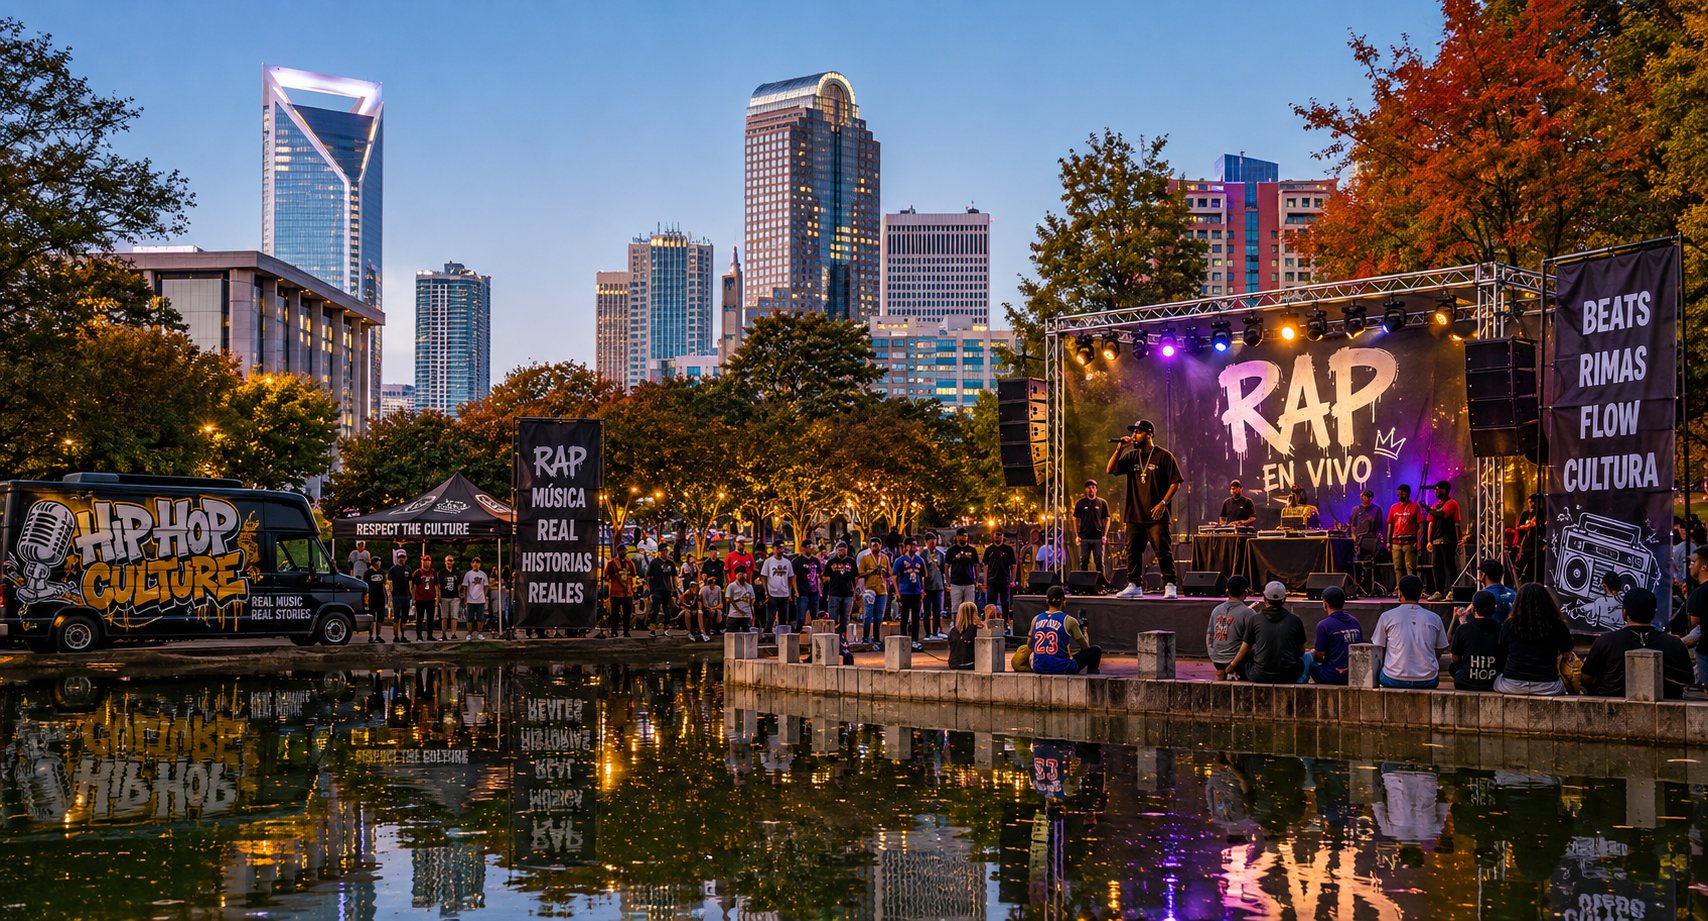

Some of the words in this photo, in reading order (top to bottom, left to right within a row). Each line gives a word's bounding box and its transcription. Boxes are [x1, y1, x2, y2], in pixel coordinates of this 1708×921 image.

[1582, 290, 1651, 336] BEATS
[1578, 345, 1648, 388] RIMAS
[1218, 345, 1399, 460] RAP
[1579, 399, 1641, 440] FLOW
[533, 445, 588, 479] RAP
[1262, 460, 1295, 493] EN
[1306, 454, 1373, 490] VIVO
[1563, 452, 1660, 493] CULTURA
[531, 483, 587, 509] MÚSICA
[152, 498, 238, 558] HOP
[356, 522, 400, 536] RESPECT
[401, 522, 422, 535] THE
[424, 522, 470, 535] CULTURE
[536, 519, 579, 541] REAL
[521, 552, 593, 573] HISTORIAS
[82, 551, 247, 611] CULTURE
[528, 581, 584, 604] REALES
[251, 595, 274, 608] REAL
[275, 595, 303, 608] MUSIC
[251, 608, 274, 621] REAL
[275, 608, 311, 620] STORIES
[1034, 631, 1058, 655] 23
[1469, 668, 1497, 680] HOP
